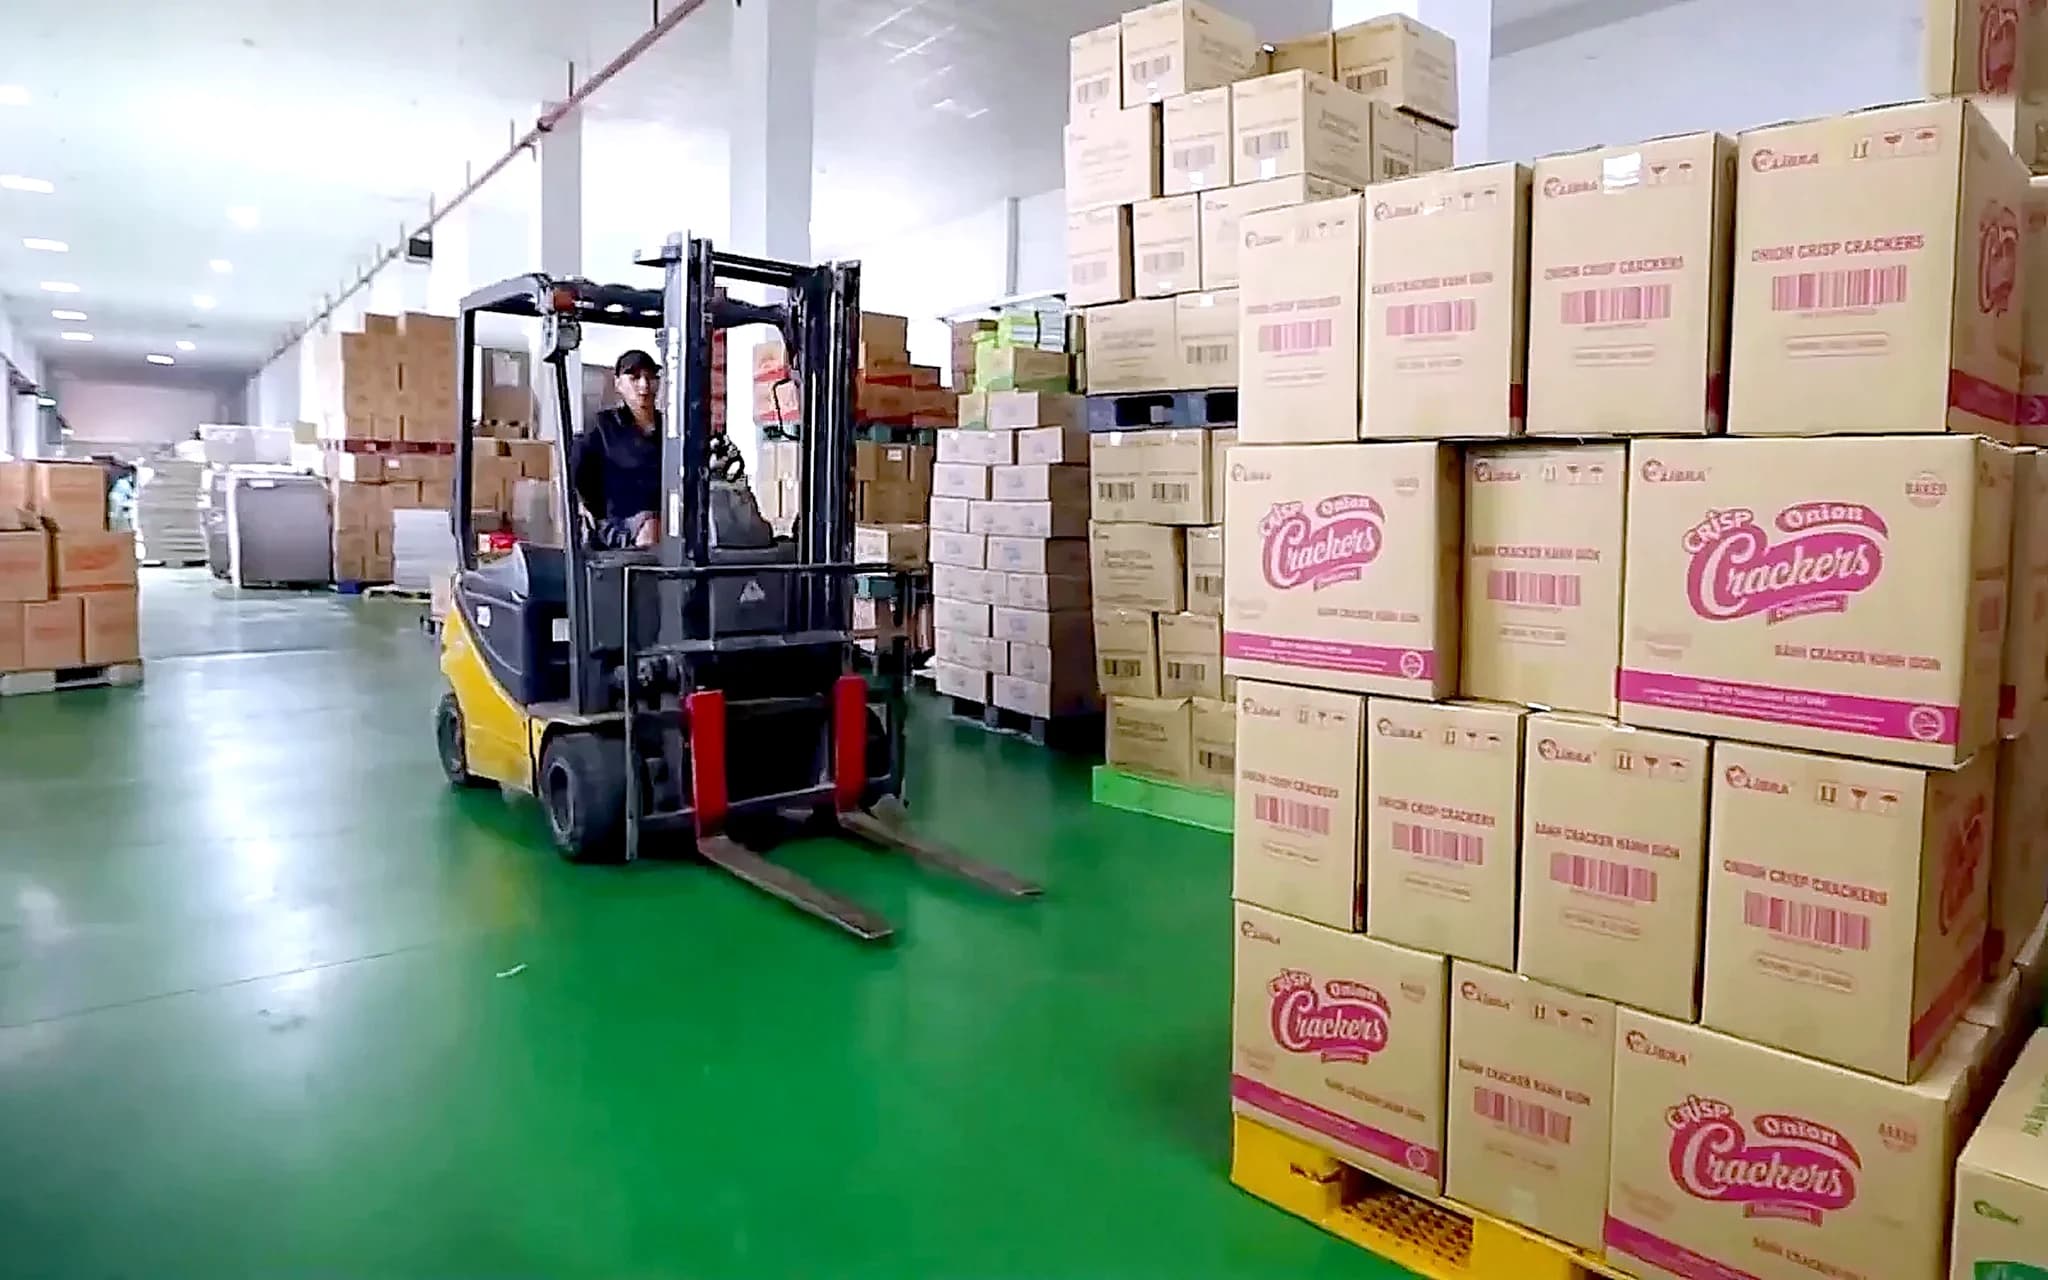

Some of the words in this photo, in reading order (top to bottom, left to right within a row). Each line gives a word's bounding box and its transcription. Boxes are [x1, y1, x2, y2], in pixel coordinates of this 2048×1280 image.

[1751, 245, 1794, 262] ONION
[1798, 240, 1841, 259] CRISP
[1844, 235, 1924, 255] CRACKERS
[1787, 505, 1863, 529] Onion
[1271, 520, 1375, 586] Crackers
[1699, 532, 1870, 617] Crackers
[1812, 876, 1888, 907] CRACKERS
[1280, 990, 1382, 1049] Crackers
[1763, 1117, 1838, 1144] Onion
[1683, 1122, 1844, 1197] Crackers
